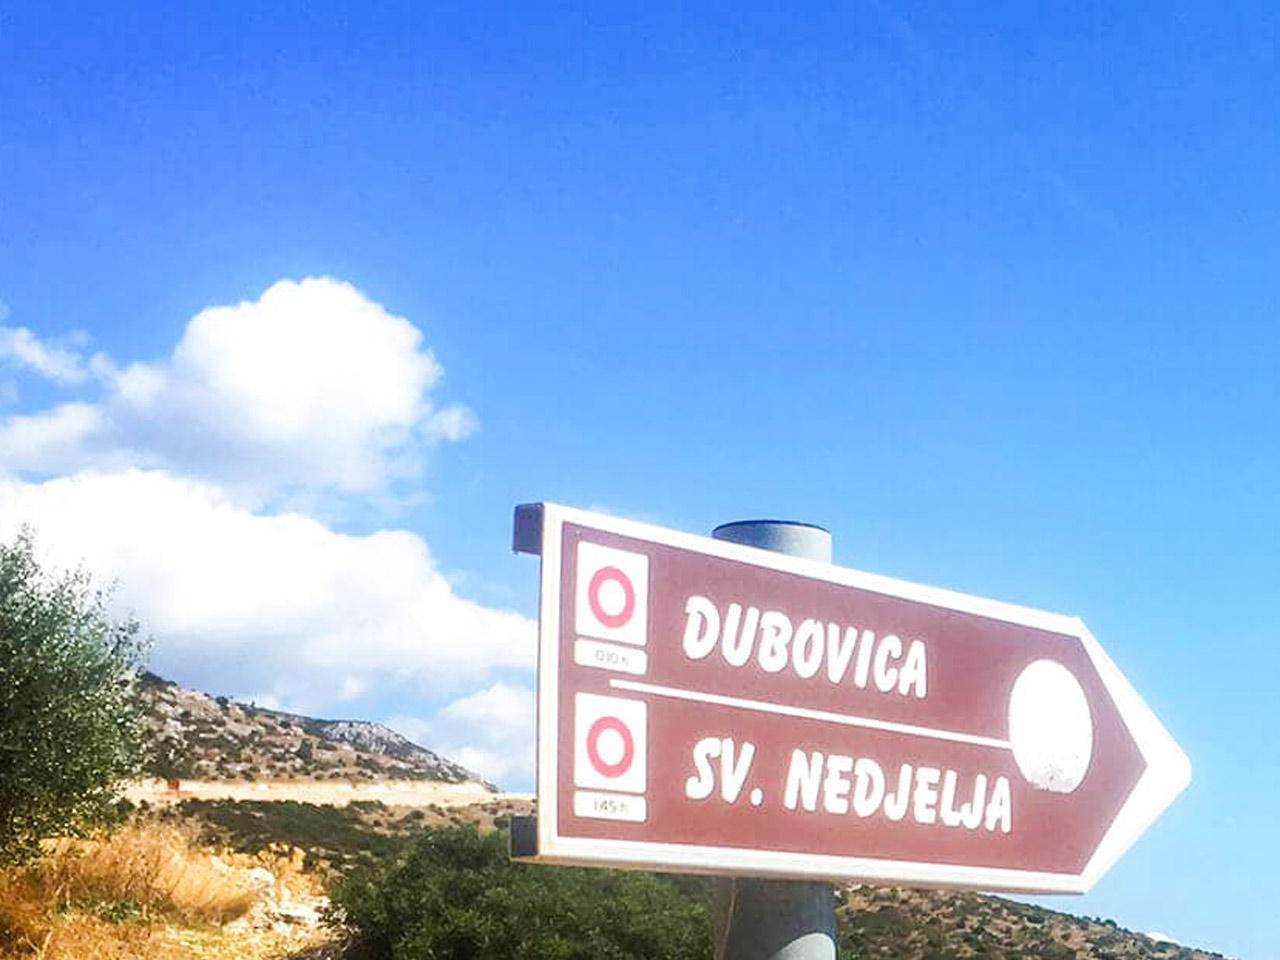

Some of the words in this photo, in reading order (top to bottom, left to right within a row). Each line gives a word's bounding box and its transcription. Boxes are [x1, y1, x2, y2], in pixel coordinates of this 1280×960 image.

[682, 595, 928, 699] DUBOVICA
[685, 737, 763, 806] SV.
[784, 748, 1012, 834] NEDJELJA
